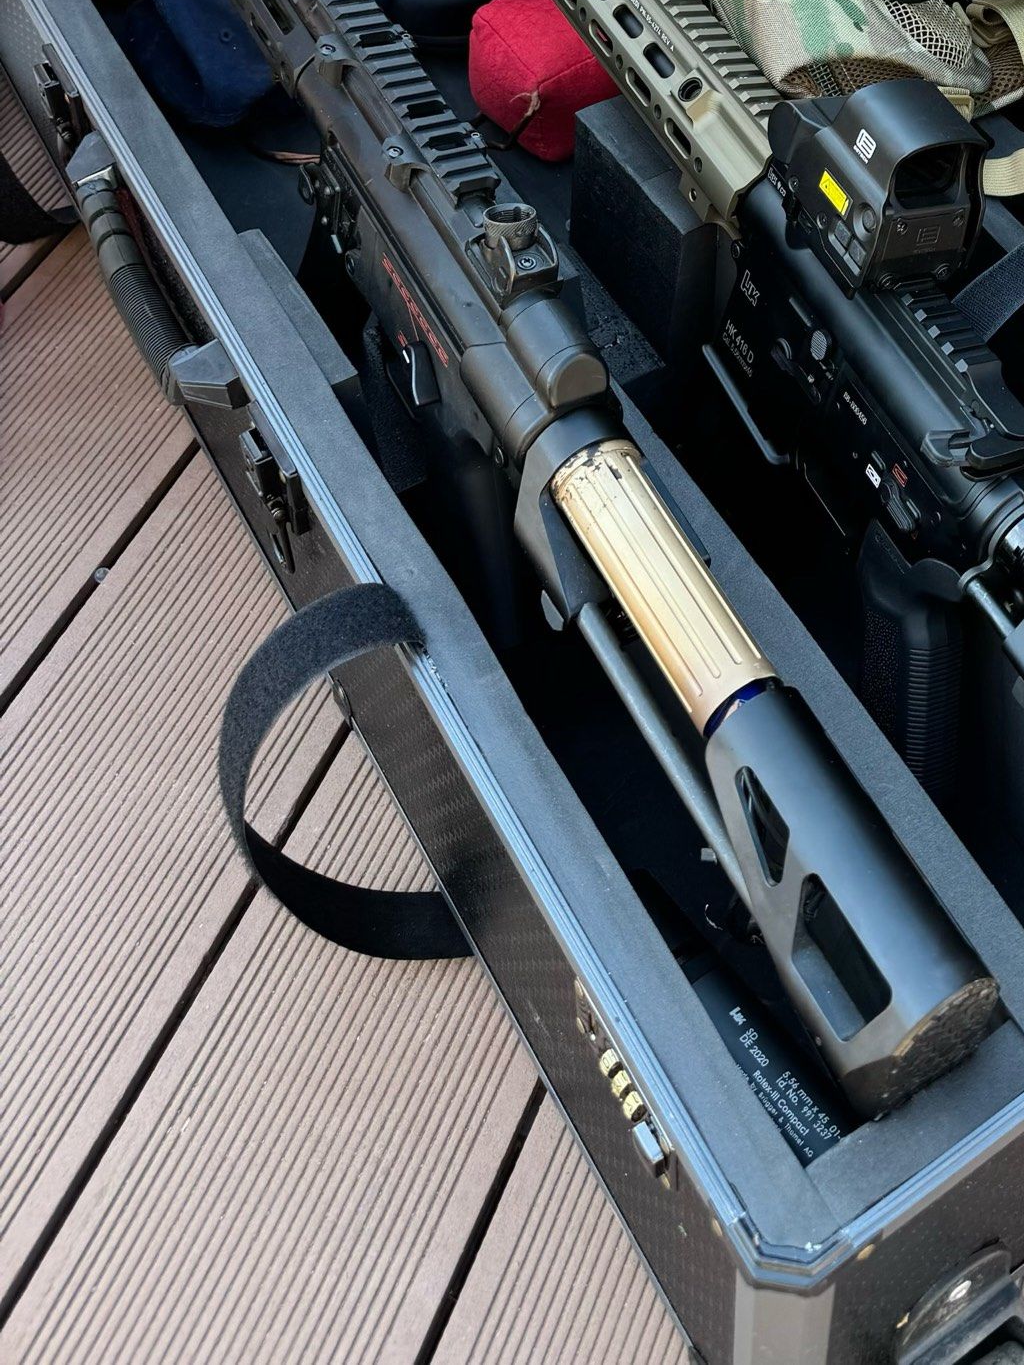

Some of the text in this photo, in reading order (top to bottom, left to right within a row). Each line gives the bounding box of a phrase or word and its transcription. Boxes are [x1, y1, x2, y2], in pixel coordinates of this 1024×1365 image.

[739, 1034, 770, 1067] DE 2020
[746, 1027, 759, 1040] SD
[777, 1098, 810, 1136] Compact
[786, 1088, 798, 1106] No.
[801, 1106, 815, 1121] 991
[813, 1122, 832, 1140] 3237
[797, 1088, 813, 1107] mm
[812, 1105, 820, 1113] x
[818, 1112, 830, 1125] 45
[778, 1116, 784, 1124] &
[803, 1147, 814, 1158] AG
